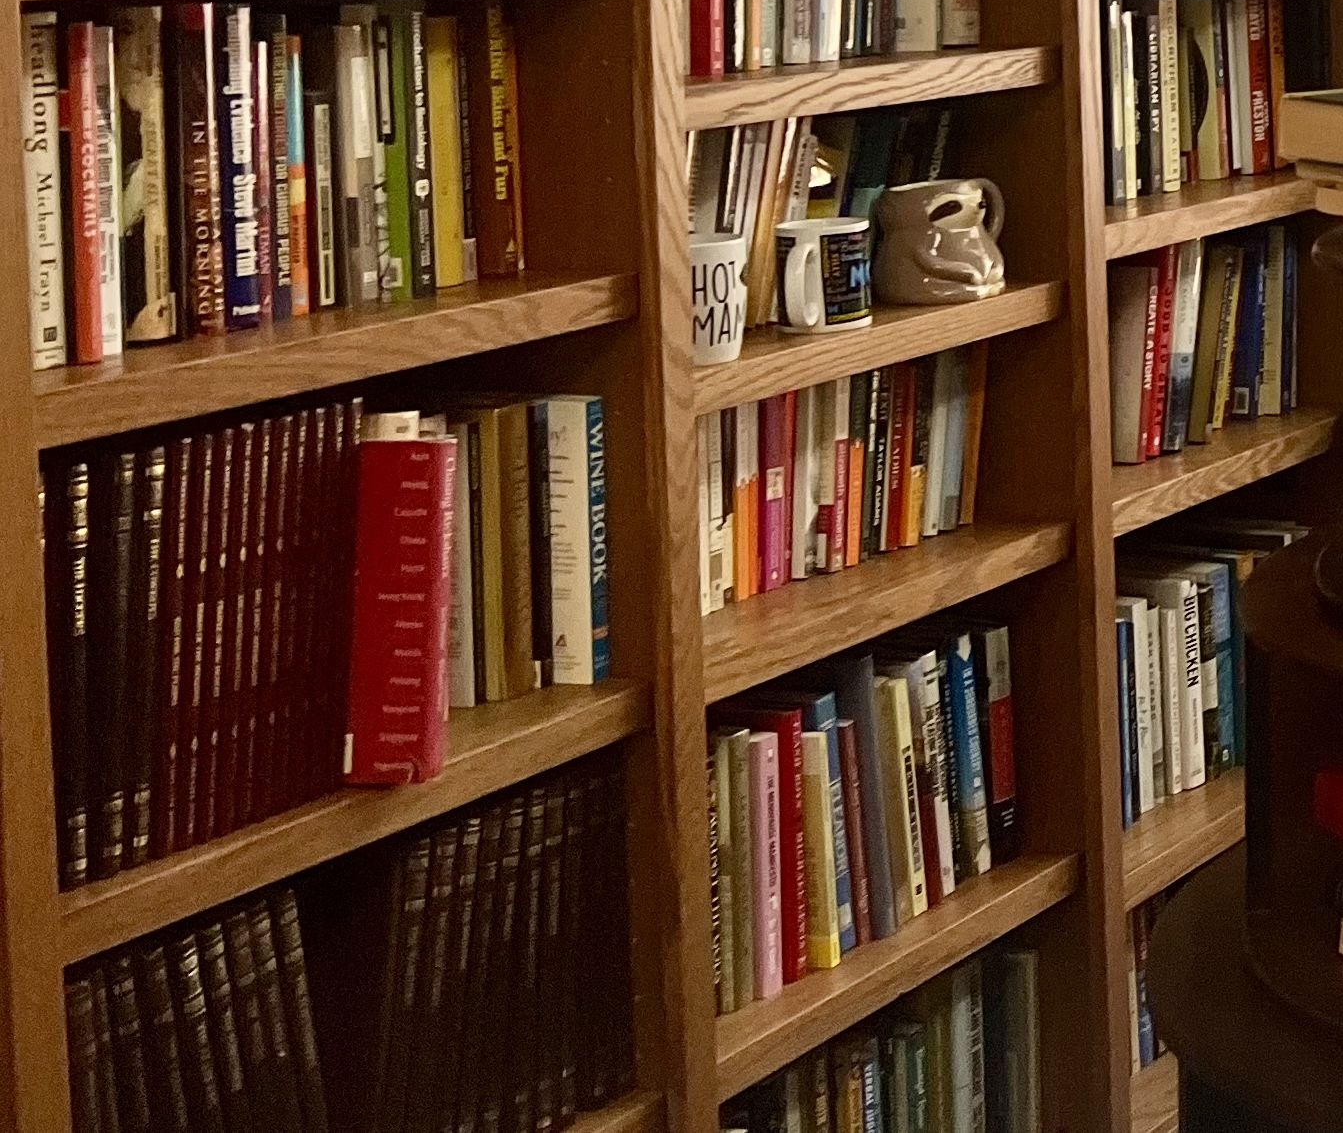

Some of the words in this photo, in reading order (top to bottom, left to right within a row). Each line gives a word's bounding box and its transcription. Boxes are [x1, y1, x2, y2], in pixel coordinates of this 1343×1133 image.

[410, 10, 425, 91] Introduction
[1150, 33, 1161, 104] LIBRARIAN
[25, 24, 58, 154] headlong
[414, 92, 424, 107] to
[192, 120, 207, 145] IN
[1152, 108, 1161, 133] SPY
[1252, 90, 1266, 143] PRESTON
[276, 156, 289, 181] FOR
[493, 131, 509, 161] and
[81, 142, 97, 238] COCKTAILS
[193, 157, 209, 197] THE
[233, 173, 257, 218] Steve
[36, 171, 63, 249] Michael
[277, 183, 290, 236] CURIOUS
[33, 258, 58, 313] Frayn
[194, 208, 212, 316] MORNING
[278, 238, 292, 288] PEOPLE
[1146, 285, 1159, 336] CREATE
[1145, 339, 1155, 350] A
[1143, 351, 1155, 391] STORY
[589, 421, 606, 497] WINE
[591, 503, 610, 586] BOOK
[1184, 596, 1199, 622] BIG
[1185, 623, 1201, 689] CHICKEN
